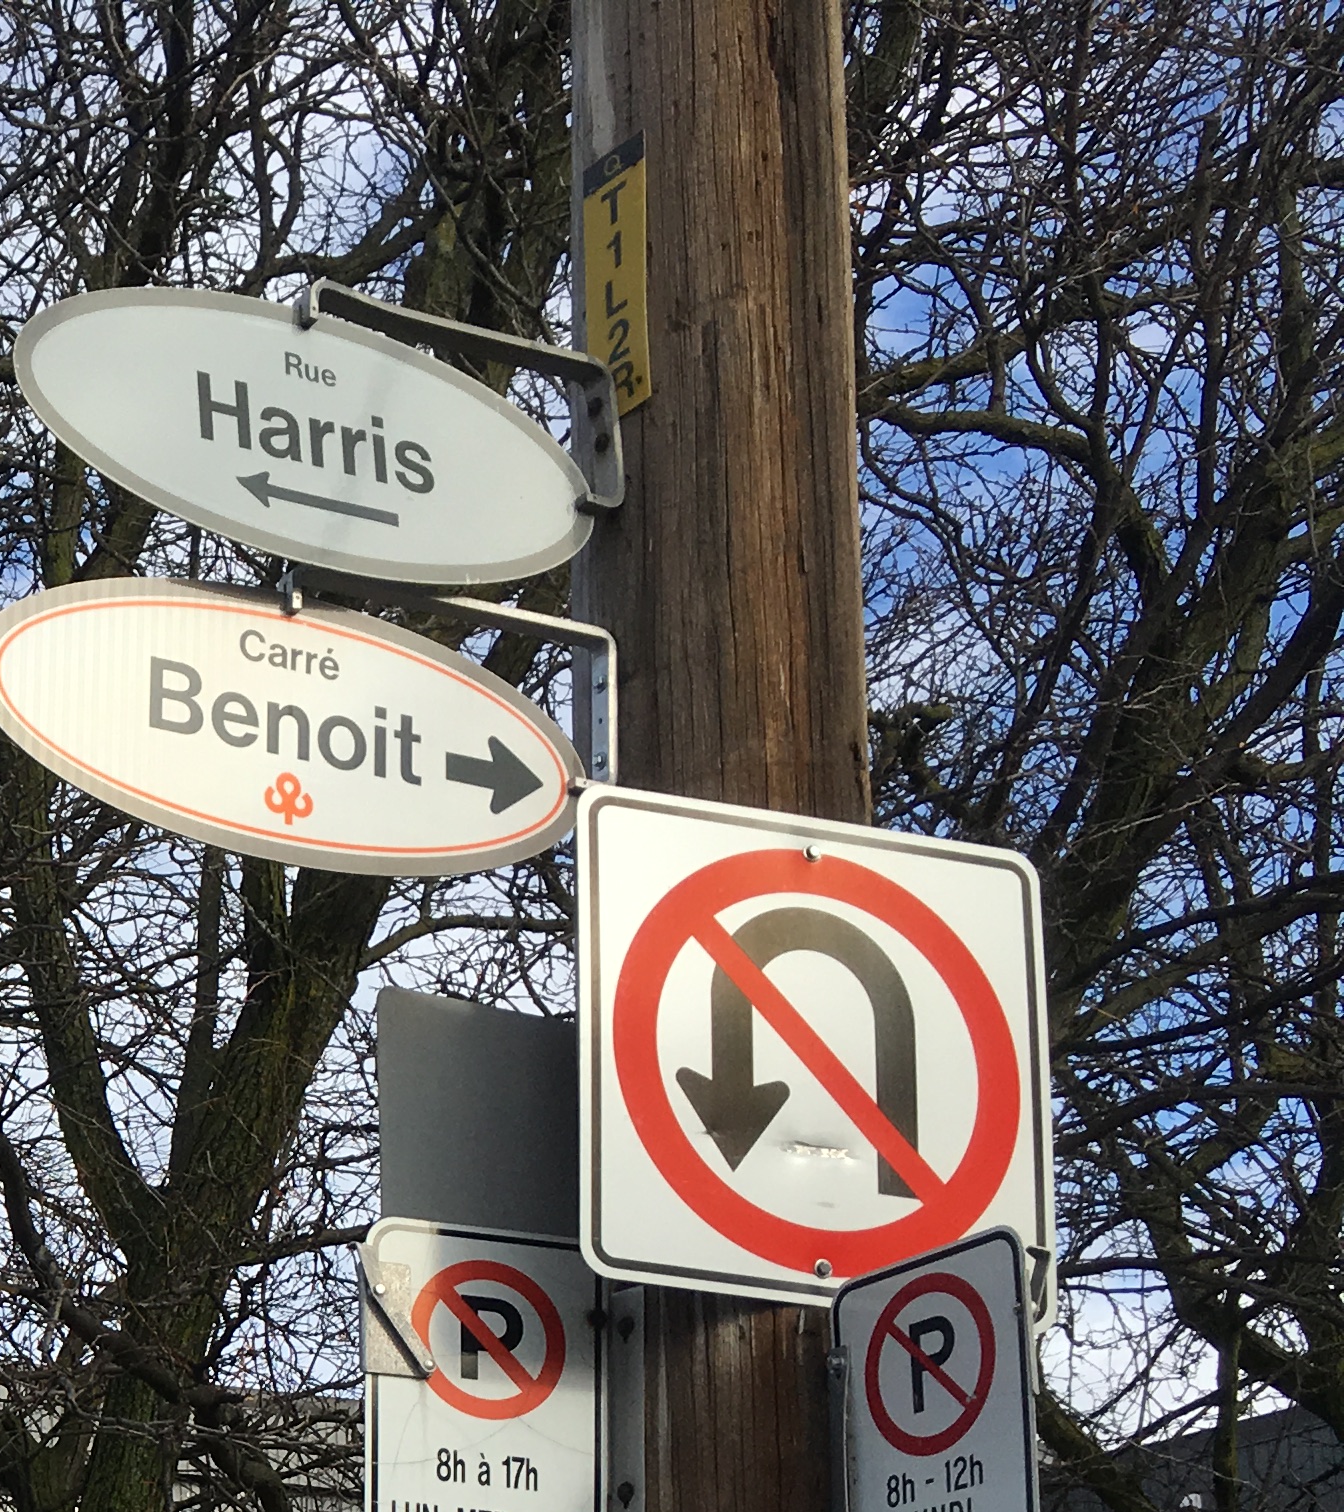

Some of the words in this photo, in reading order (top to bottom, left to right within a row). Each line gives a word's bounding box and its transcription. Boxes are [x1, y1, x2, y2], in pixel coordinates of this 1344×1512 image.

[284, 351, 337, 387] Rue
[196, 370, 435, 494] Harris
[239, 630, 339, 681] Carré
[149, 655, 422, 786] Benoit
[437, 1448, 466, 1483] 8h
[477, 1453, 491, 1487] à
[502, 1456, 538, 1491] 17h
[887, 1472, 916, 1508] 8h
[944, 1454, 984, 1494] 12h
